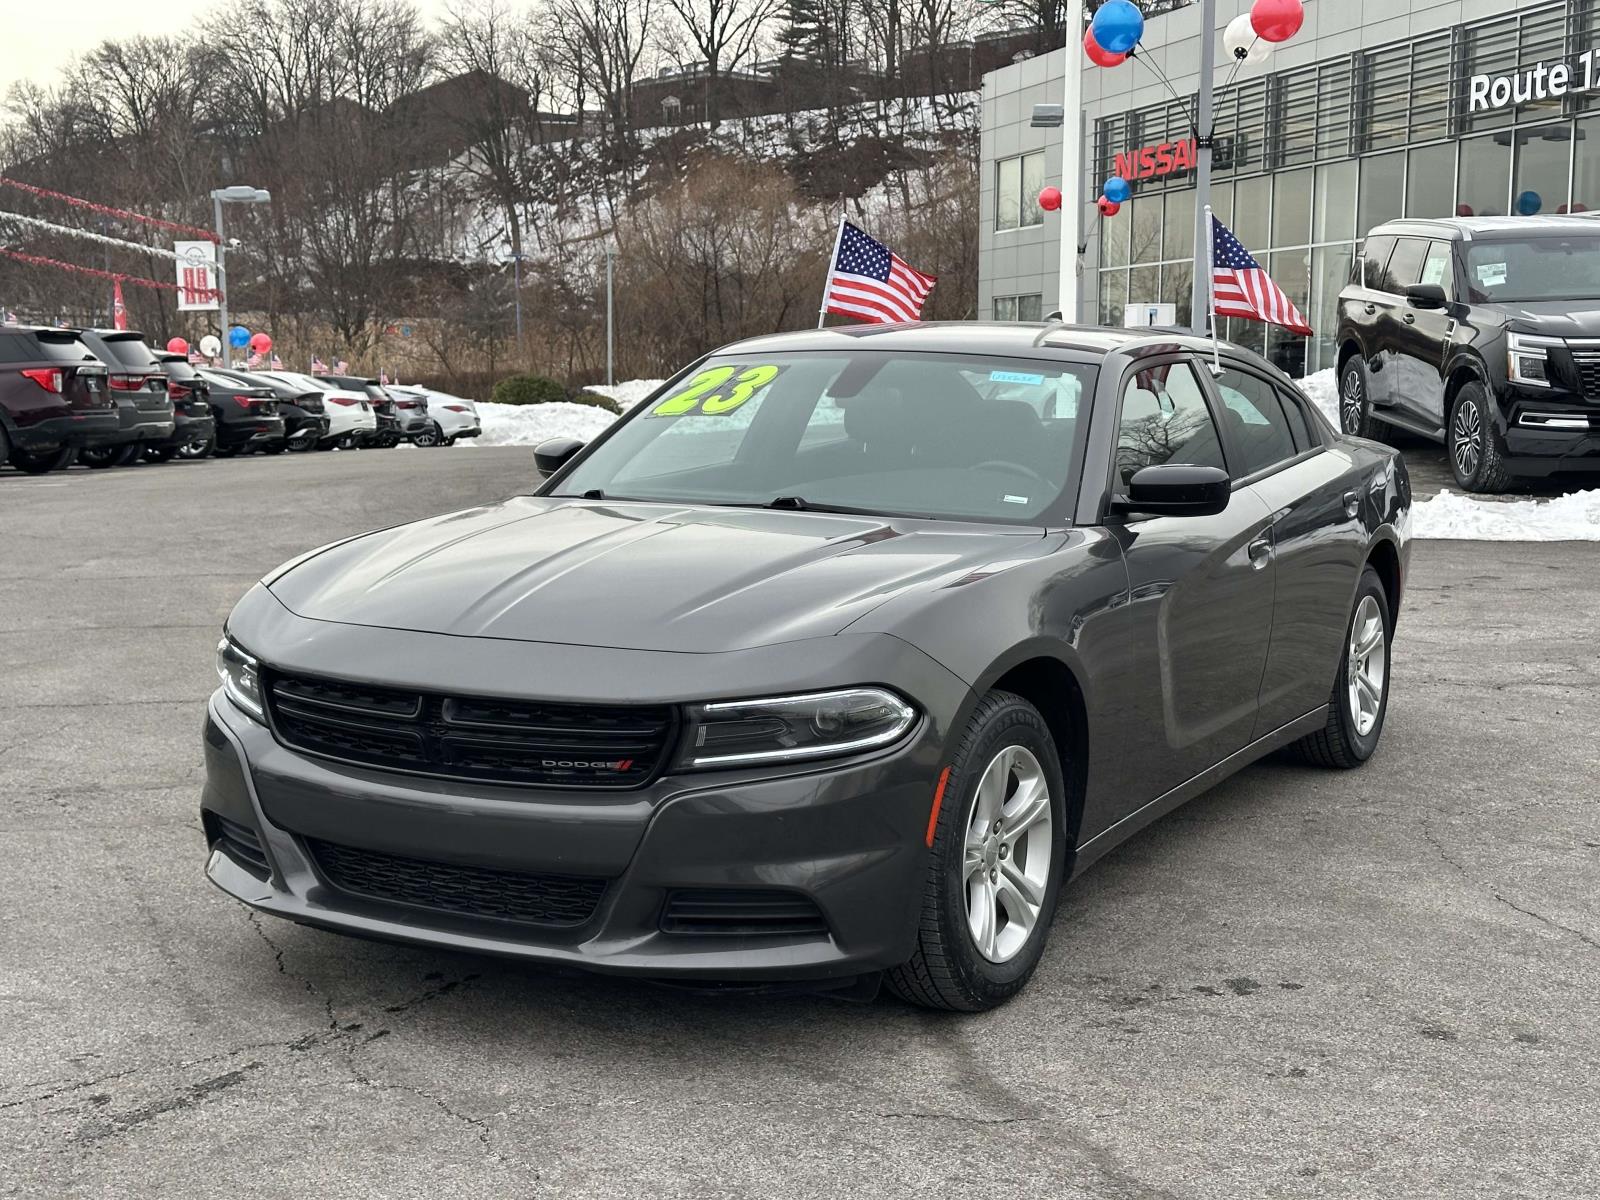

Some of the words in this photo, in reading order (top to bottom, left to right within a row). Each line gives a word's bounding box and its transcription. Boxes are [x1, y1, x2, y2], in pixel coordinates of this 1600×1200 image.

[1469, 61, 1569, 112] Route
[652, 365, 779, 416] 23
[541, 759, 618, 769] DODGE
